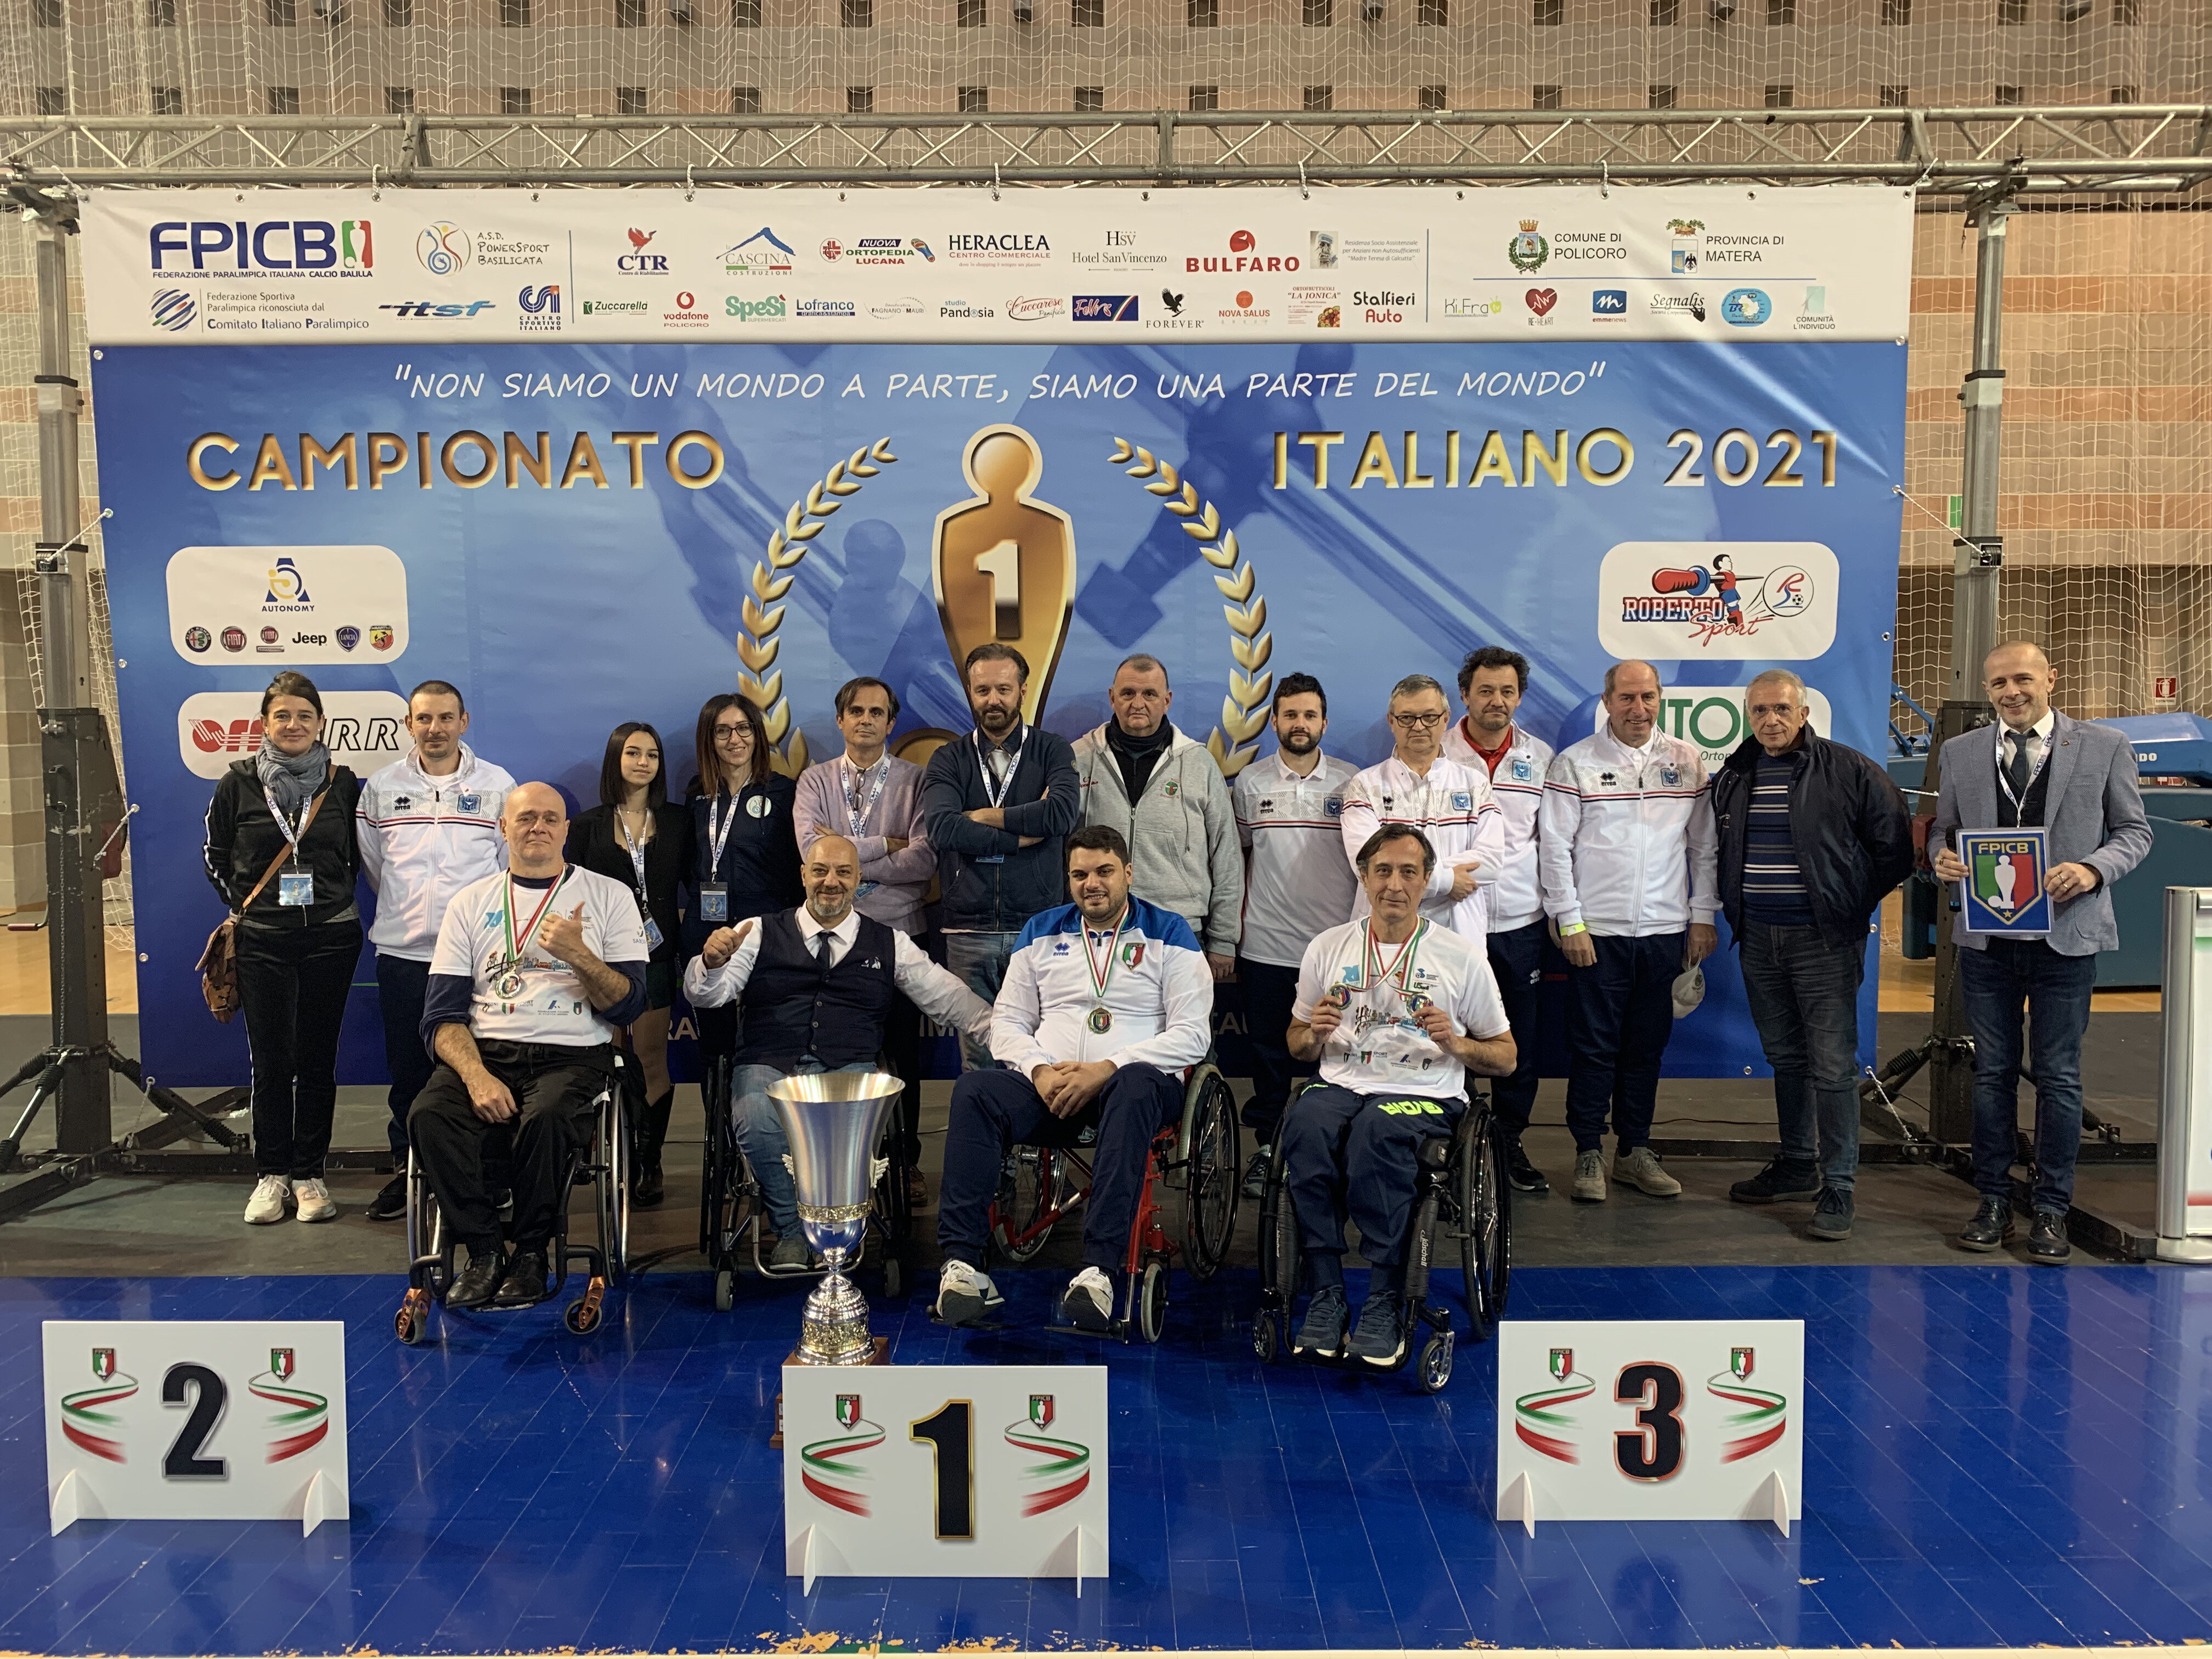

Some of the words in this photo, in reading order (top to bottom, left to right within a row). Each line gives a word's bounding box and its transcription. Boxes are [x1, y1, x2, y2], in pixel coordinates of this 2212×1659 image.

[949, 235, 1050, 250] HERACLEA
[1555, 233, 1606, 242] COMUNE
[1707, 236, 1769, 245] PROVINCIA
[1774, 236, 1784, 245] DI
[150, 222, 336, 269] FPICB
[726, 253, 791, 264] CASCINA
[1073, 252, 1099, 263] Hotel
[1555, 247, 1626, 259] POLICORO
[1706, 251, 1761, 262] MATERA
[618, 255, 669, 270] CTR
[1187, 257, 1300, 272] BULFARO
[261, 292, 295, 302] Sportiva
[1353, 291, 1415, 305] Stalfieri
[1651, 292, 1705, 309] Segnalis
[207, 304, 256, 313] Paralimpica
[259, 303, 309, 312] riconosciuta
[312, 303, 324, 311] dal
[594, 301, 647, 310] Zuccarella
[797, 299, 854, 311] Lofranco
[1006, 296, 1063, 315] Cuccarese
[1445, 298, 1488, 313] Ki.Fra
[664, 312, 709, 320] vodafone
[940, 307, 994, 318] Pandosia
[1039, 309, 1065, 318] Panificio
[1366, 309, 1402, 323] Auto
[207, 319, 257, 329] Comitato
[262, 318, 301, 329] Italiano
[306, 318, 369, 330] Paralimpico
[502, 374, 610, 398] SIAMO
[631, 374, 678, 398] UN
[697, 374, 825, 398] MONDO
[841, 374, 866, 398] A
[887, 374, 1009, 404] PARTE,
[1029, 374, 1137, 399] SIAMO
[1158, 374, 1223, 398] UNA
[1246, 373, 1357, 398] PARTE
[1374, 373, 1437, 397] DEL
[187, 429, 725, 491] CAMPIONATO
[1273, 427, 1634, 489] ITALIANO
[1663, 428, 1837, 488] 2021
[974, 539, 1022, 641] 1
[1623, 597, 1725, 622] ROBERTO
[1689, 611, 1773, 647] Sport
[227, 634, 241, 644] FIAT
[292, 632, 326, 645] Jeep
[1978, 842, 2029, 854] FPICB
[160, 1362, 228, 1482] 2
[1613, 1361, 1685, 1482] 3
[909, 1399, 974, 1540] 1
